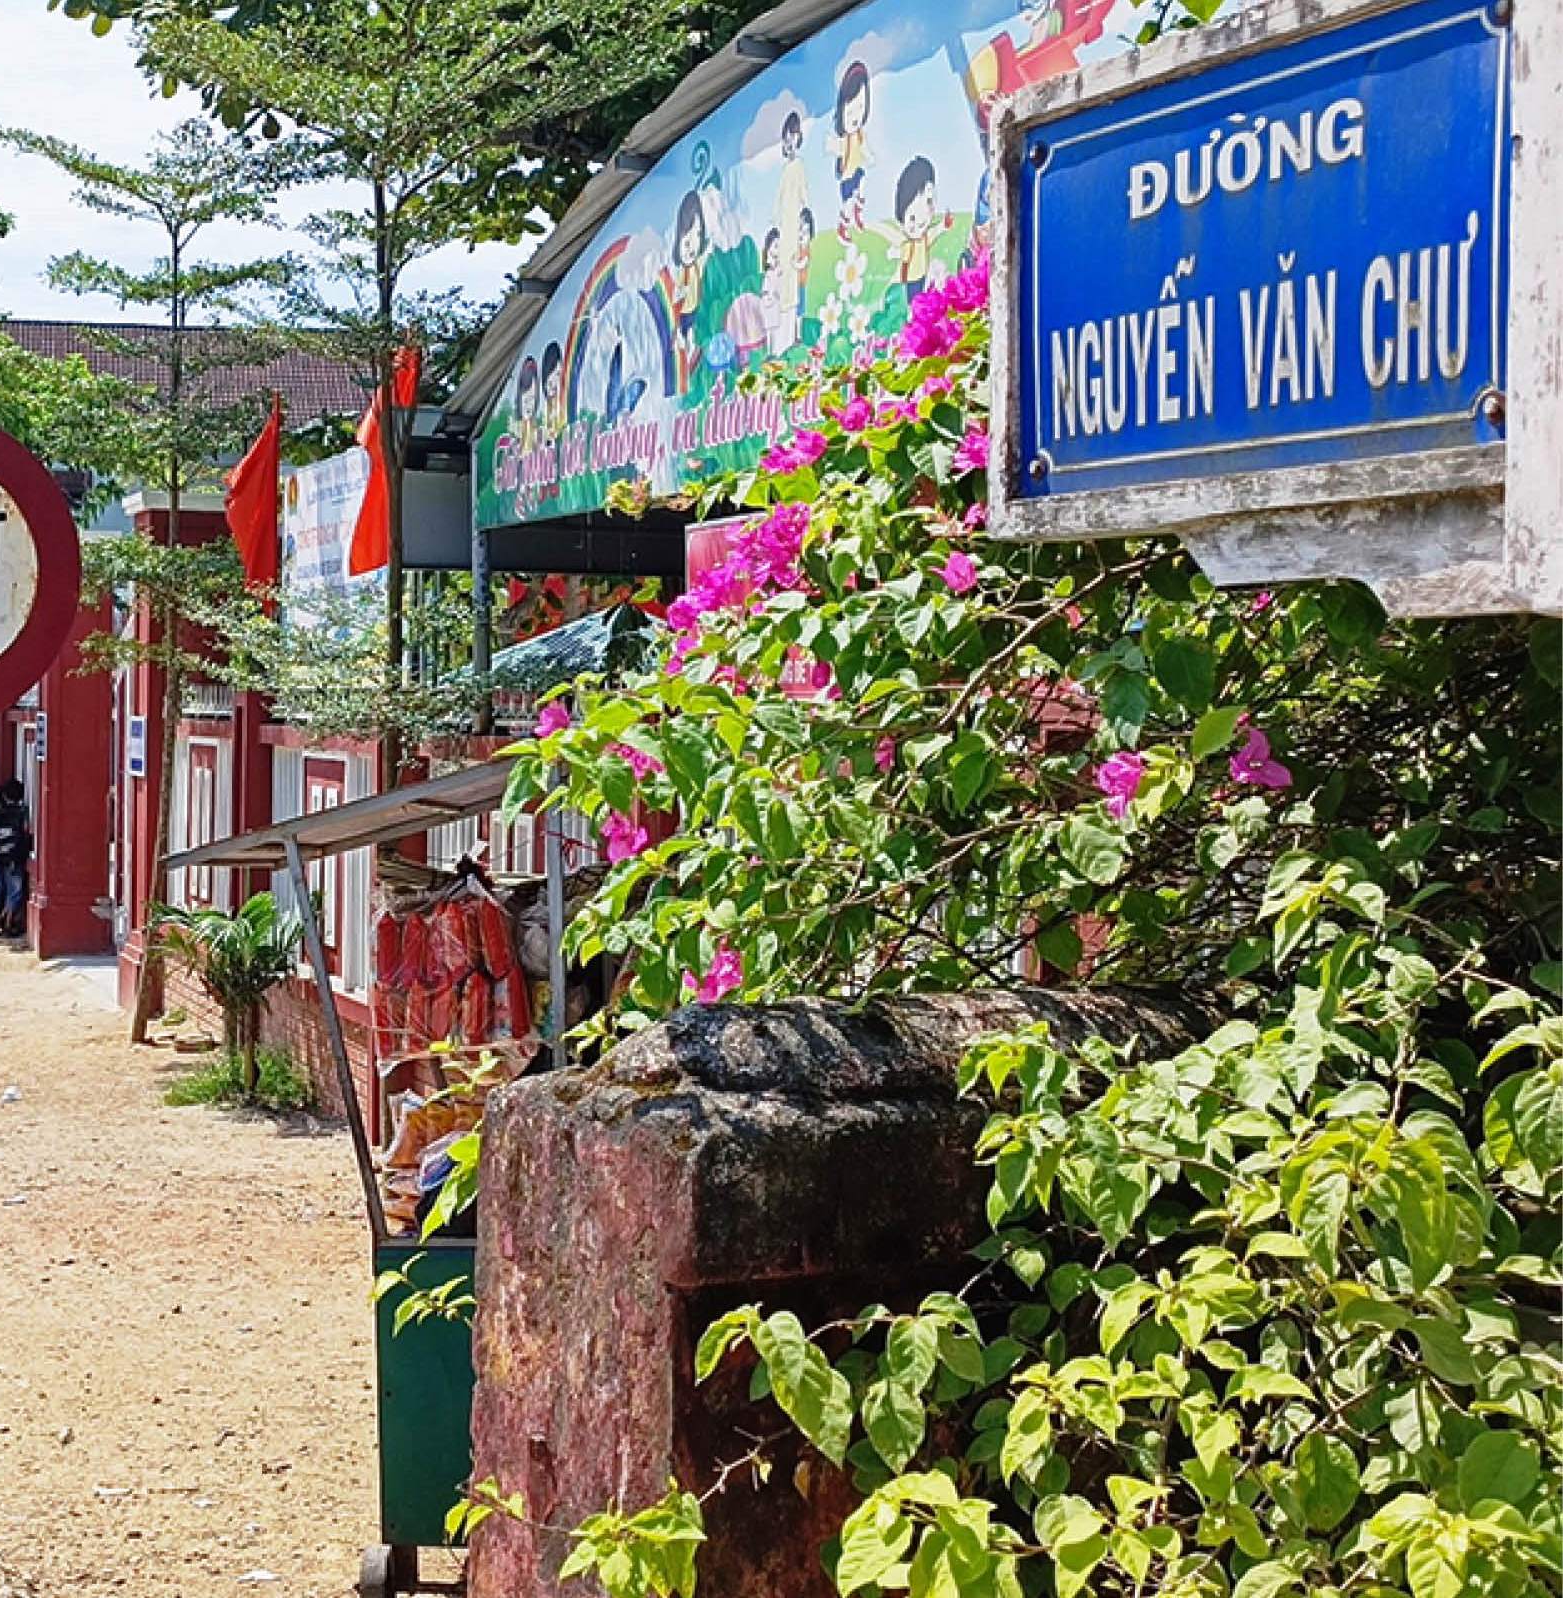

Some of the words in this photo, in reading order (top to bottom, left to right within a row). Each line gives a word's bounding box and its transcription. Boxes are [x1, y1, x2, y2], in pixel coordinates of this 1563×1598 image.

[1127, 98, 1365, 221] ĐƯỜNG
[1050, 254, 1216, 440] NGUYỄN
[1239, 250, 1337, 410] VĂN
[1360, 210, 1479, 390] CHƯ
